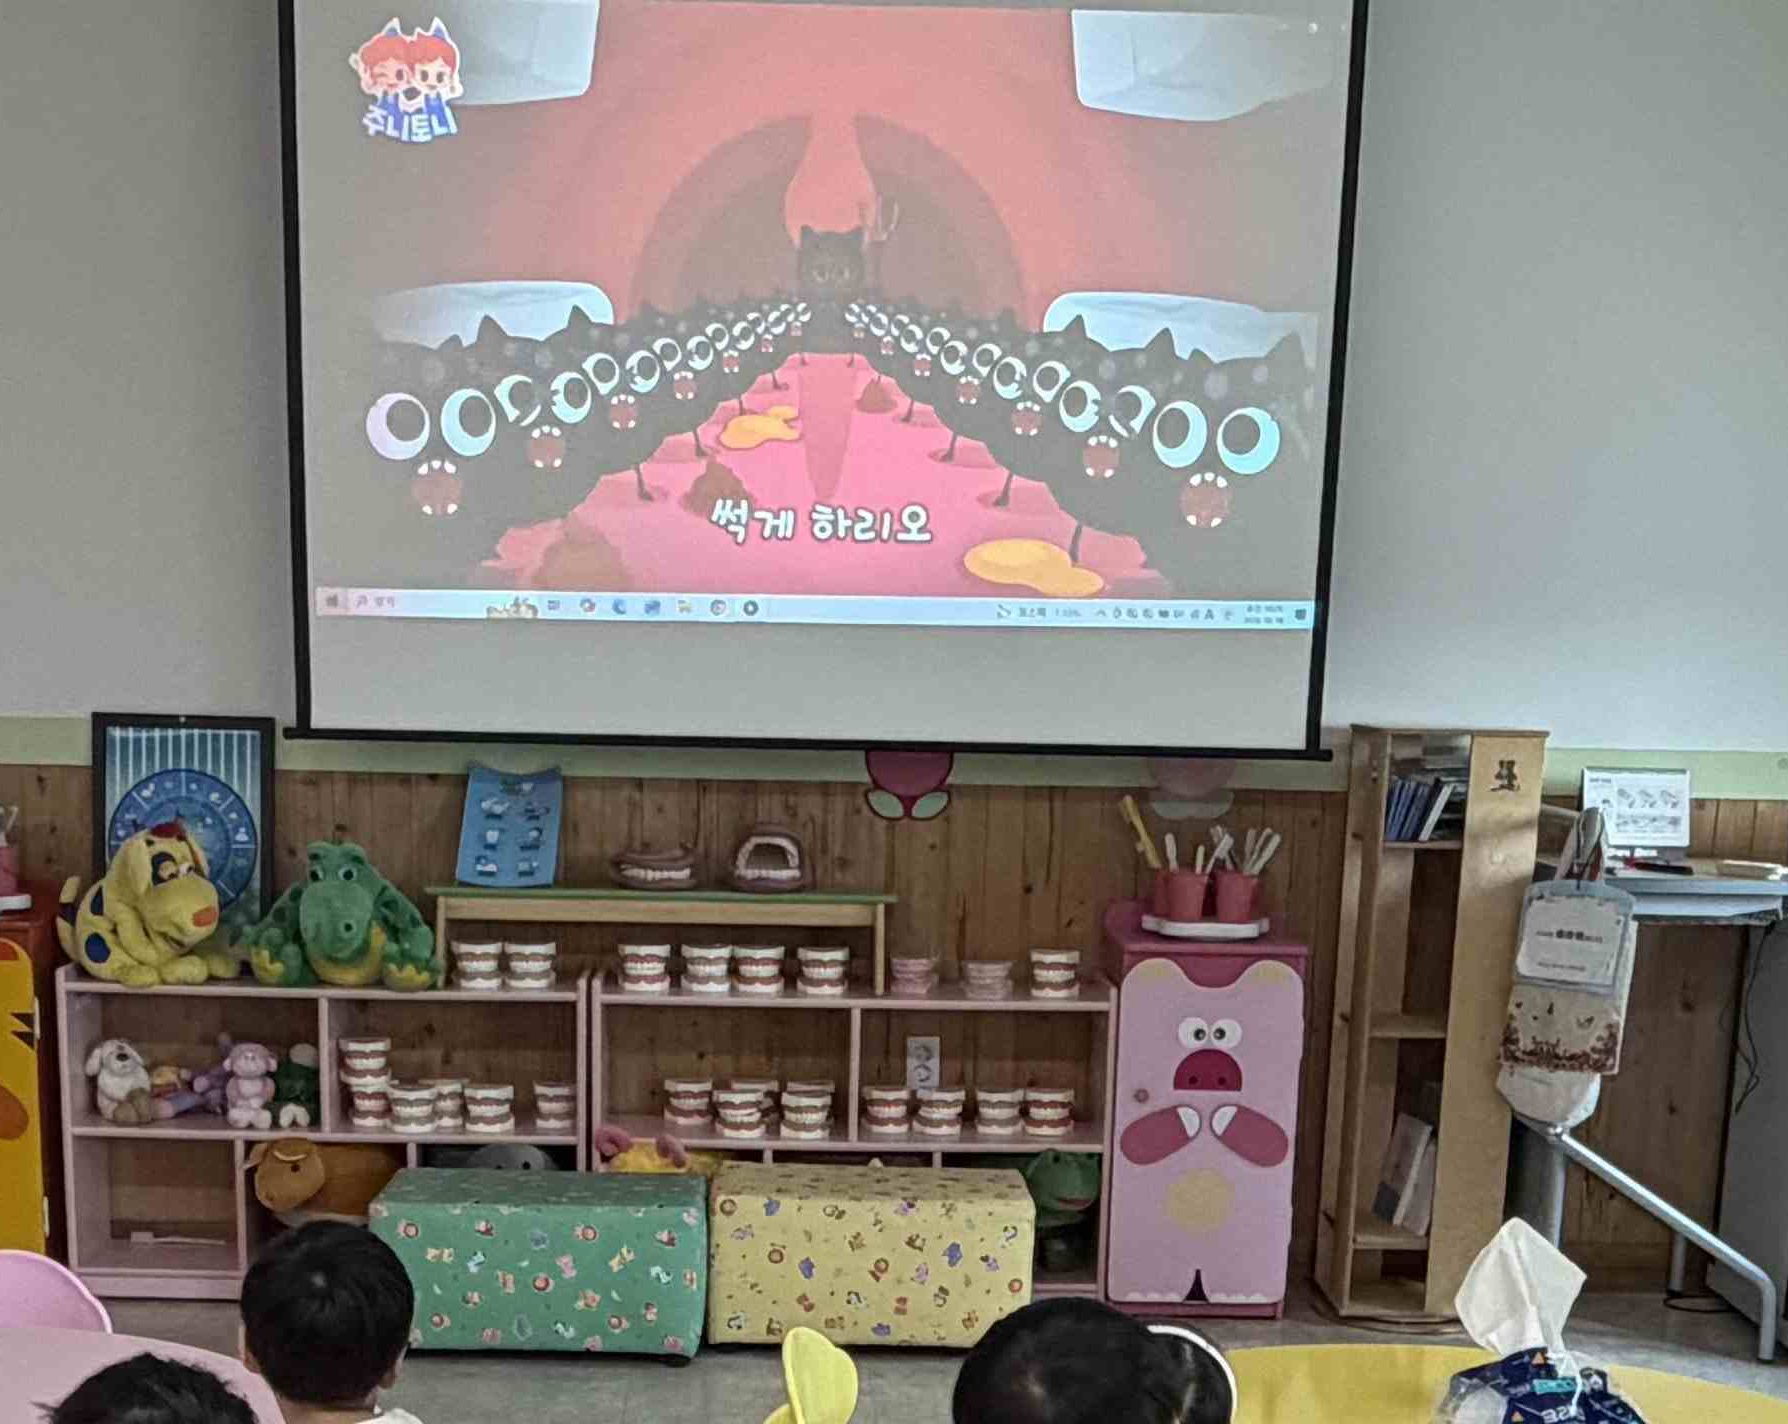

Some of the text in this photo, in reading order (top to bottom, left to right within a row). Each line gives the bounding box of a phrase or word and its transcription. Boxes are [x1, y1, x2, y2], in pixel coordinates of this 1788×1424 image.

[362, 103, 458, 142] 주니토니
[711, 498, 933, 544] 썩게 하리오
